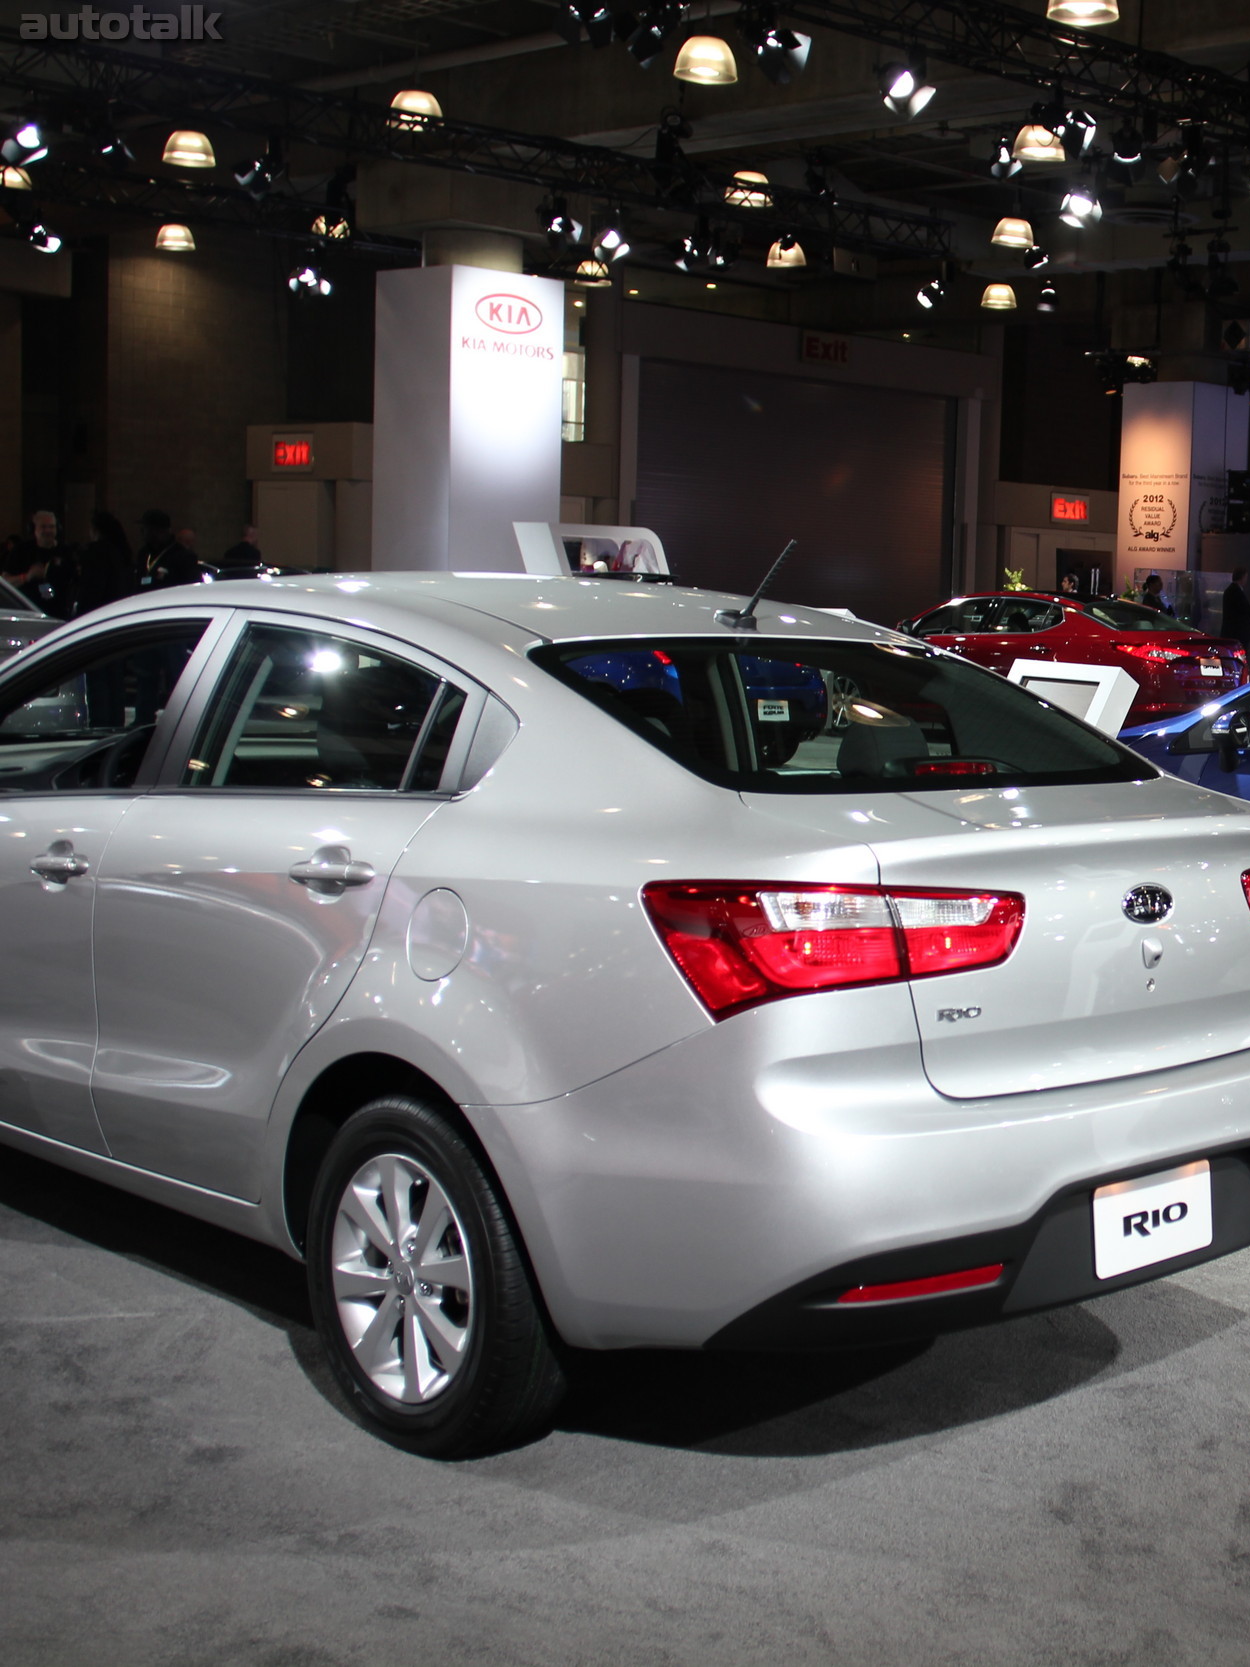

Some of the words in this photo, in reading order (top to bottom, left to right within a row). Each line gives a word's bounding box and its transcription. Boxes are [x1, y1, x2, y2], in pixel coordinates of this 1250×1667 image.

[489, 302, 531, 326] KIA
[462, 336, 486, 351] KIA
[493, 341, 554, 361] MOTORS
[806, 336, 848, 363] Exit
[1053, 498, 1087, 520] Exit
[1143, 495, 1164, 503] 2012
[1145, 529, 1159, 542] alg
[1122, 1202, 1188, 1237] RIO
